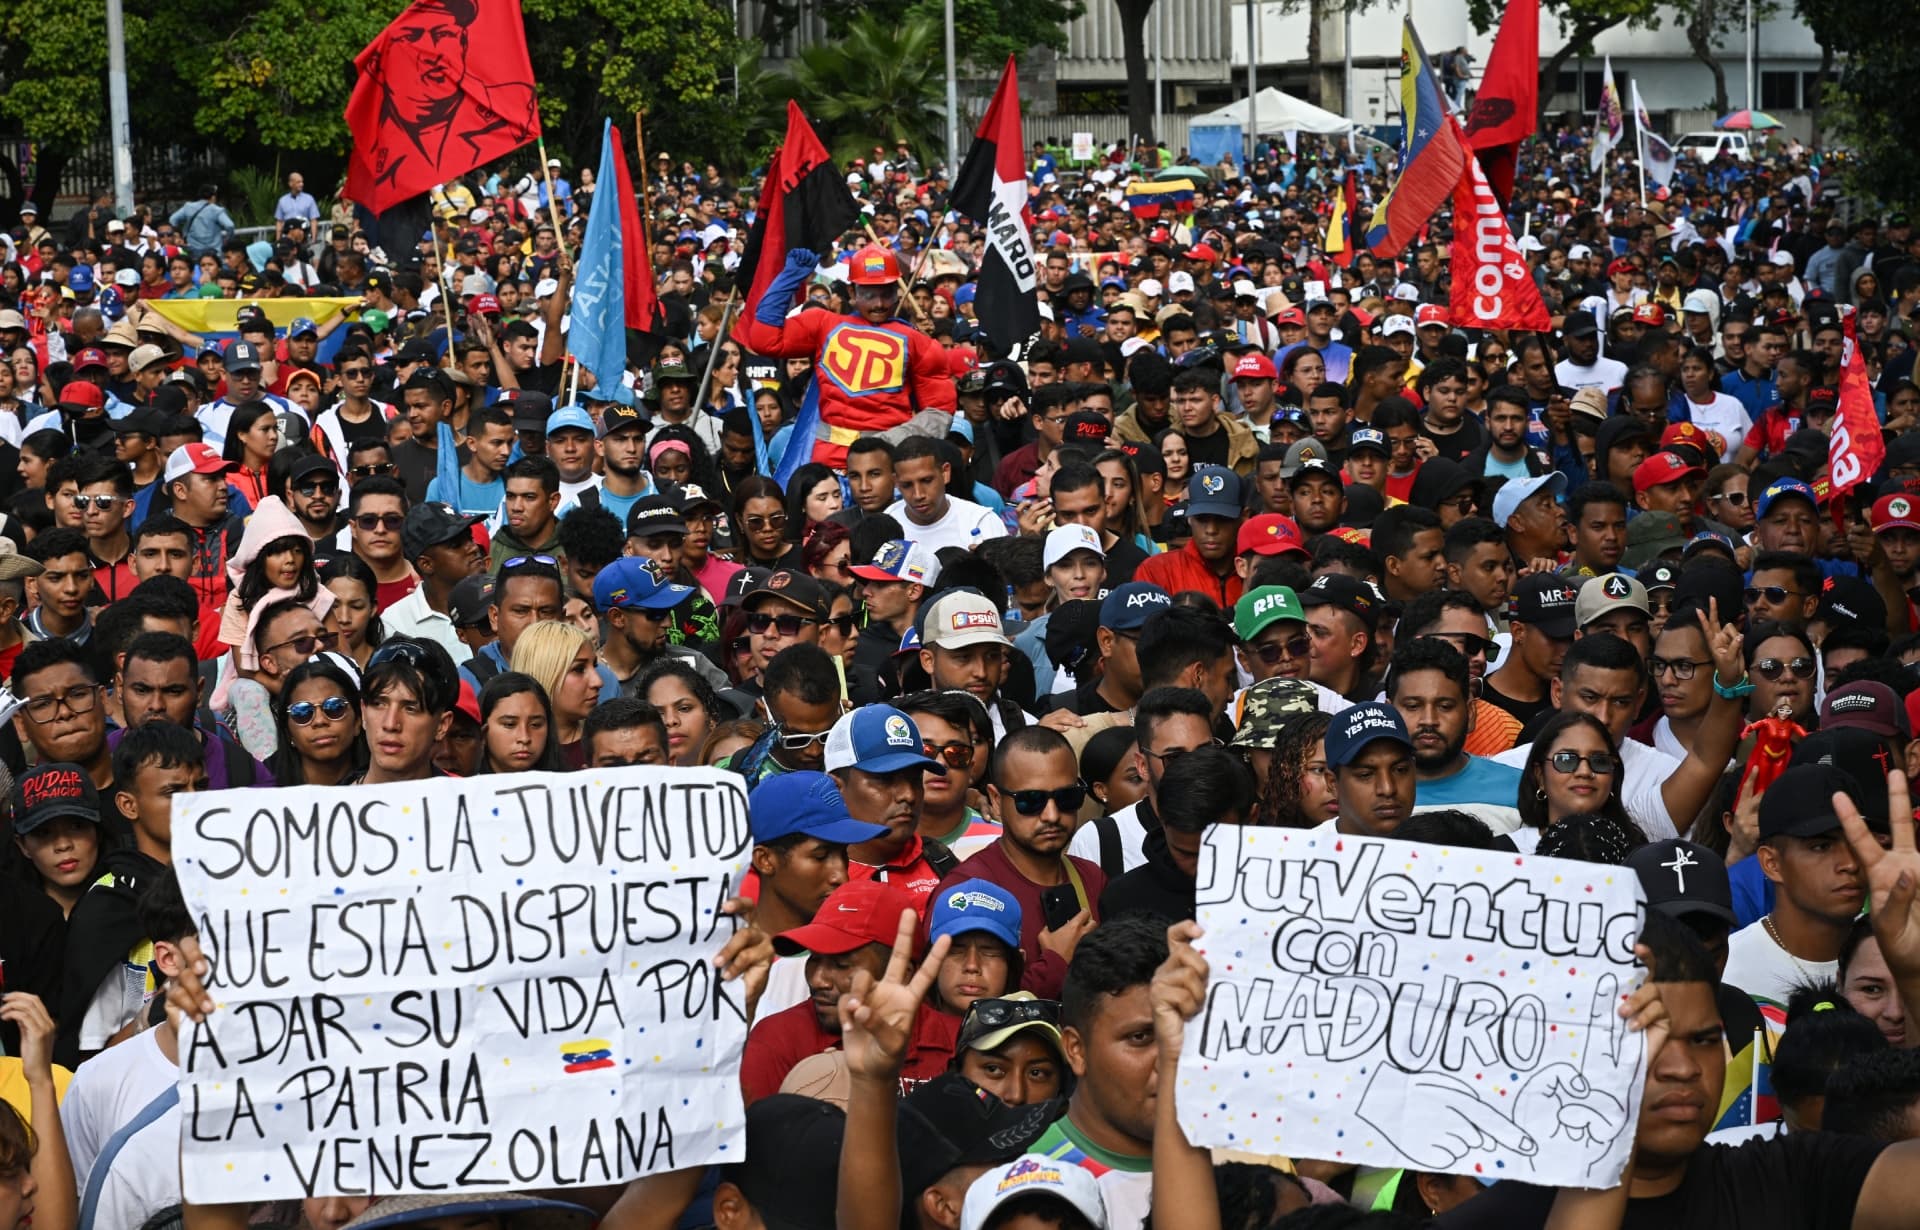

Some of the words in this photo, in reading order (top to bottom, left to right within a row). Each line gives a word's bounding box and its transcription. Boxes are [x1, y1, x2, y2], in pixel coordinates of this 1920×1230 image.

[1345, 722, 1363, 739] YES
[1350, 711, 1365, 723] NO
[22, 770, 83, 797] DUDAR
[195, 800, 399, 880] SOMOS
[423, 794, 482, 874] LA
[495, 782, 752, 867] JUVENTUD
[307, 885, 438, 982] ESTÁ
[451, 872, 738, 973] DISPUESTA
[1271, 916, 1398, 977] con
[187, 1016, 228, 1073] A
[233, 992, 363, 1065] DAR
[385, 987, 462, 1049] SU
[493, 967, 625, 1039] VIDA
[1200, 974, 1546, 1072] MADURO
[191, 1077, 265, 1142] LA
[277, 1052, 489, 1131] PATRIA
[283, 1106, 675, 1198] VENEZOLANA
